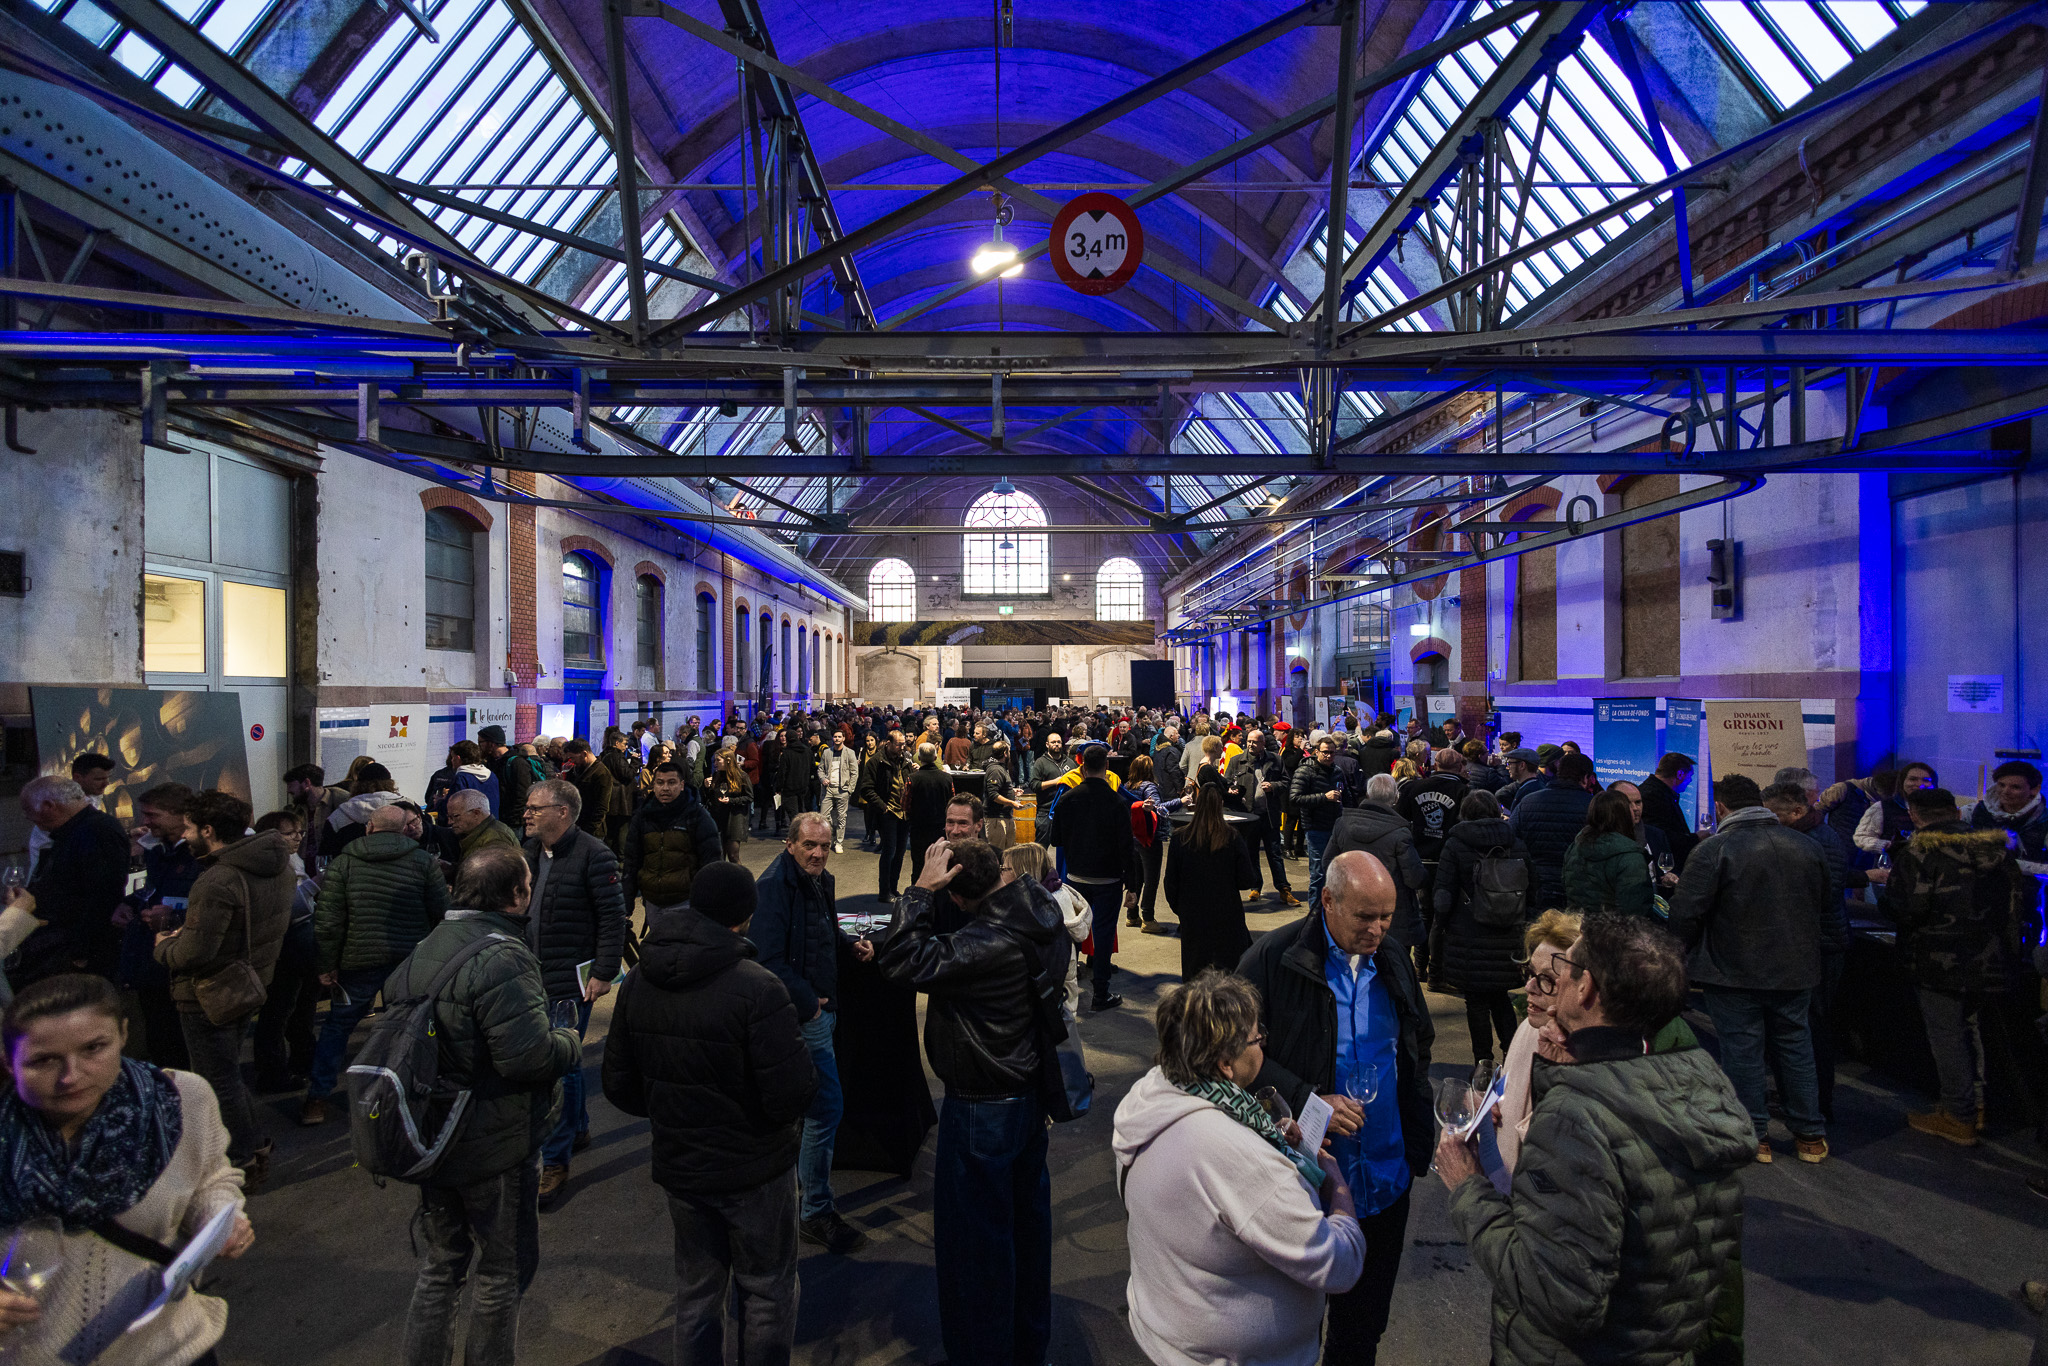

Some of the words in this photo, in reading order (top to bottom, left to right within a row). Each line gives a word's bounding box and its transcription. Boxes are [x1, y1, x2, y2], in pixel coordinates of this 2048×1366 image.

[1618, 709, 1650, 717] CHAUX-DE-FONDS
[1723, 719, 1784, 730] GRISONI
[1750, 749, 1771, 757] monde
[1596, 766, 1623, 775] Métropole
[1624, 768, 1650, 778] horlogère
[1415, 792, 1455, 810] VOODOO
